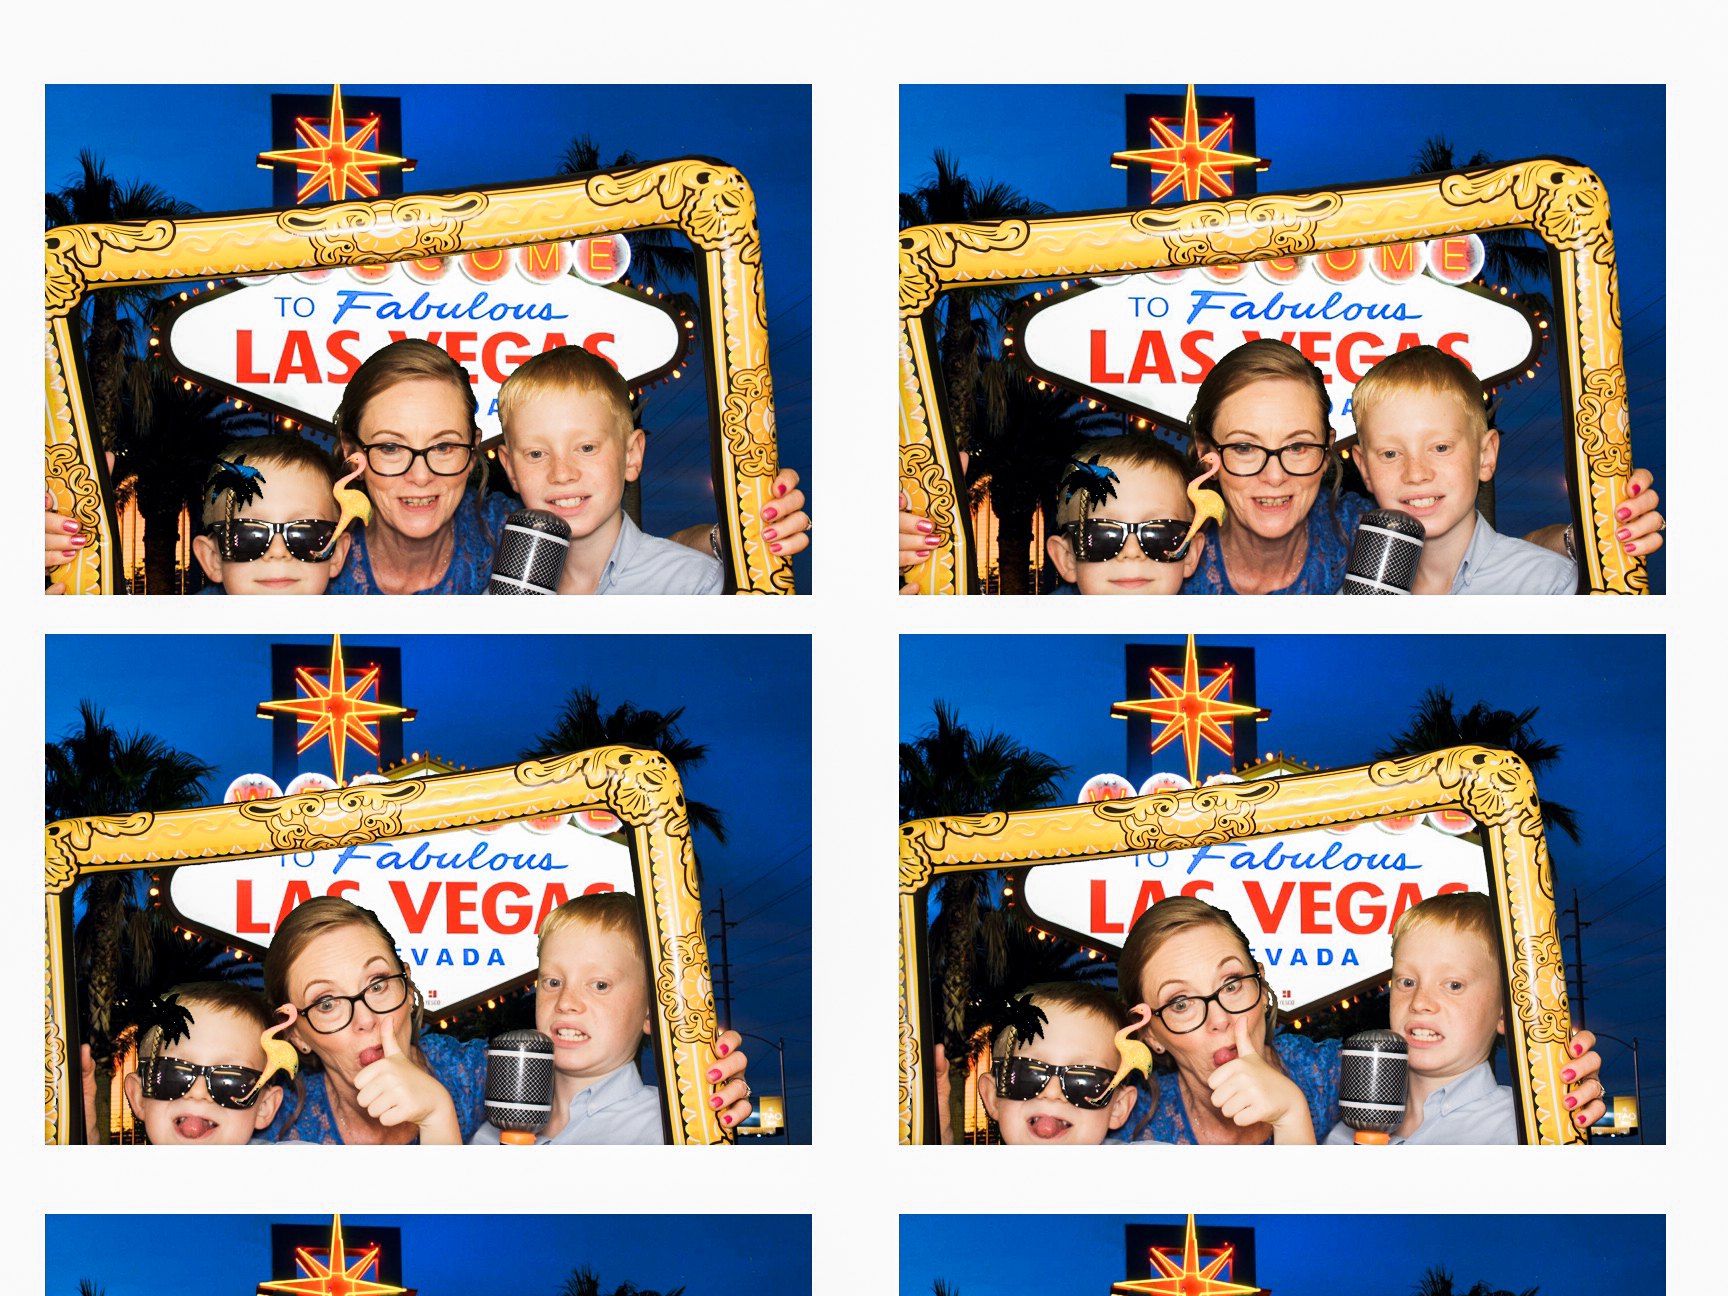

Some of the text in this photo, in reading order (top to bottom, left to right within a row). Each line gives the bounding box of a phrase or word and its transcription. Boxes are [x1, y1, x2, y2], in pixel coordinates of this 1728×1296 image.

[274, 290, 569, 325] TO Fabulous
[1128, 290, 1423, 325] TO Fabulous
